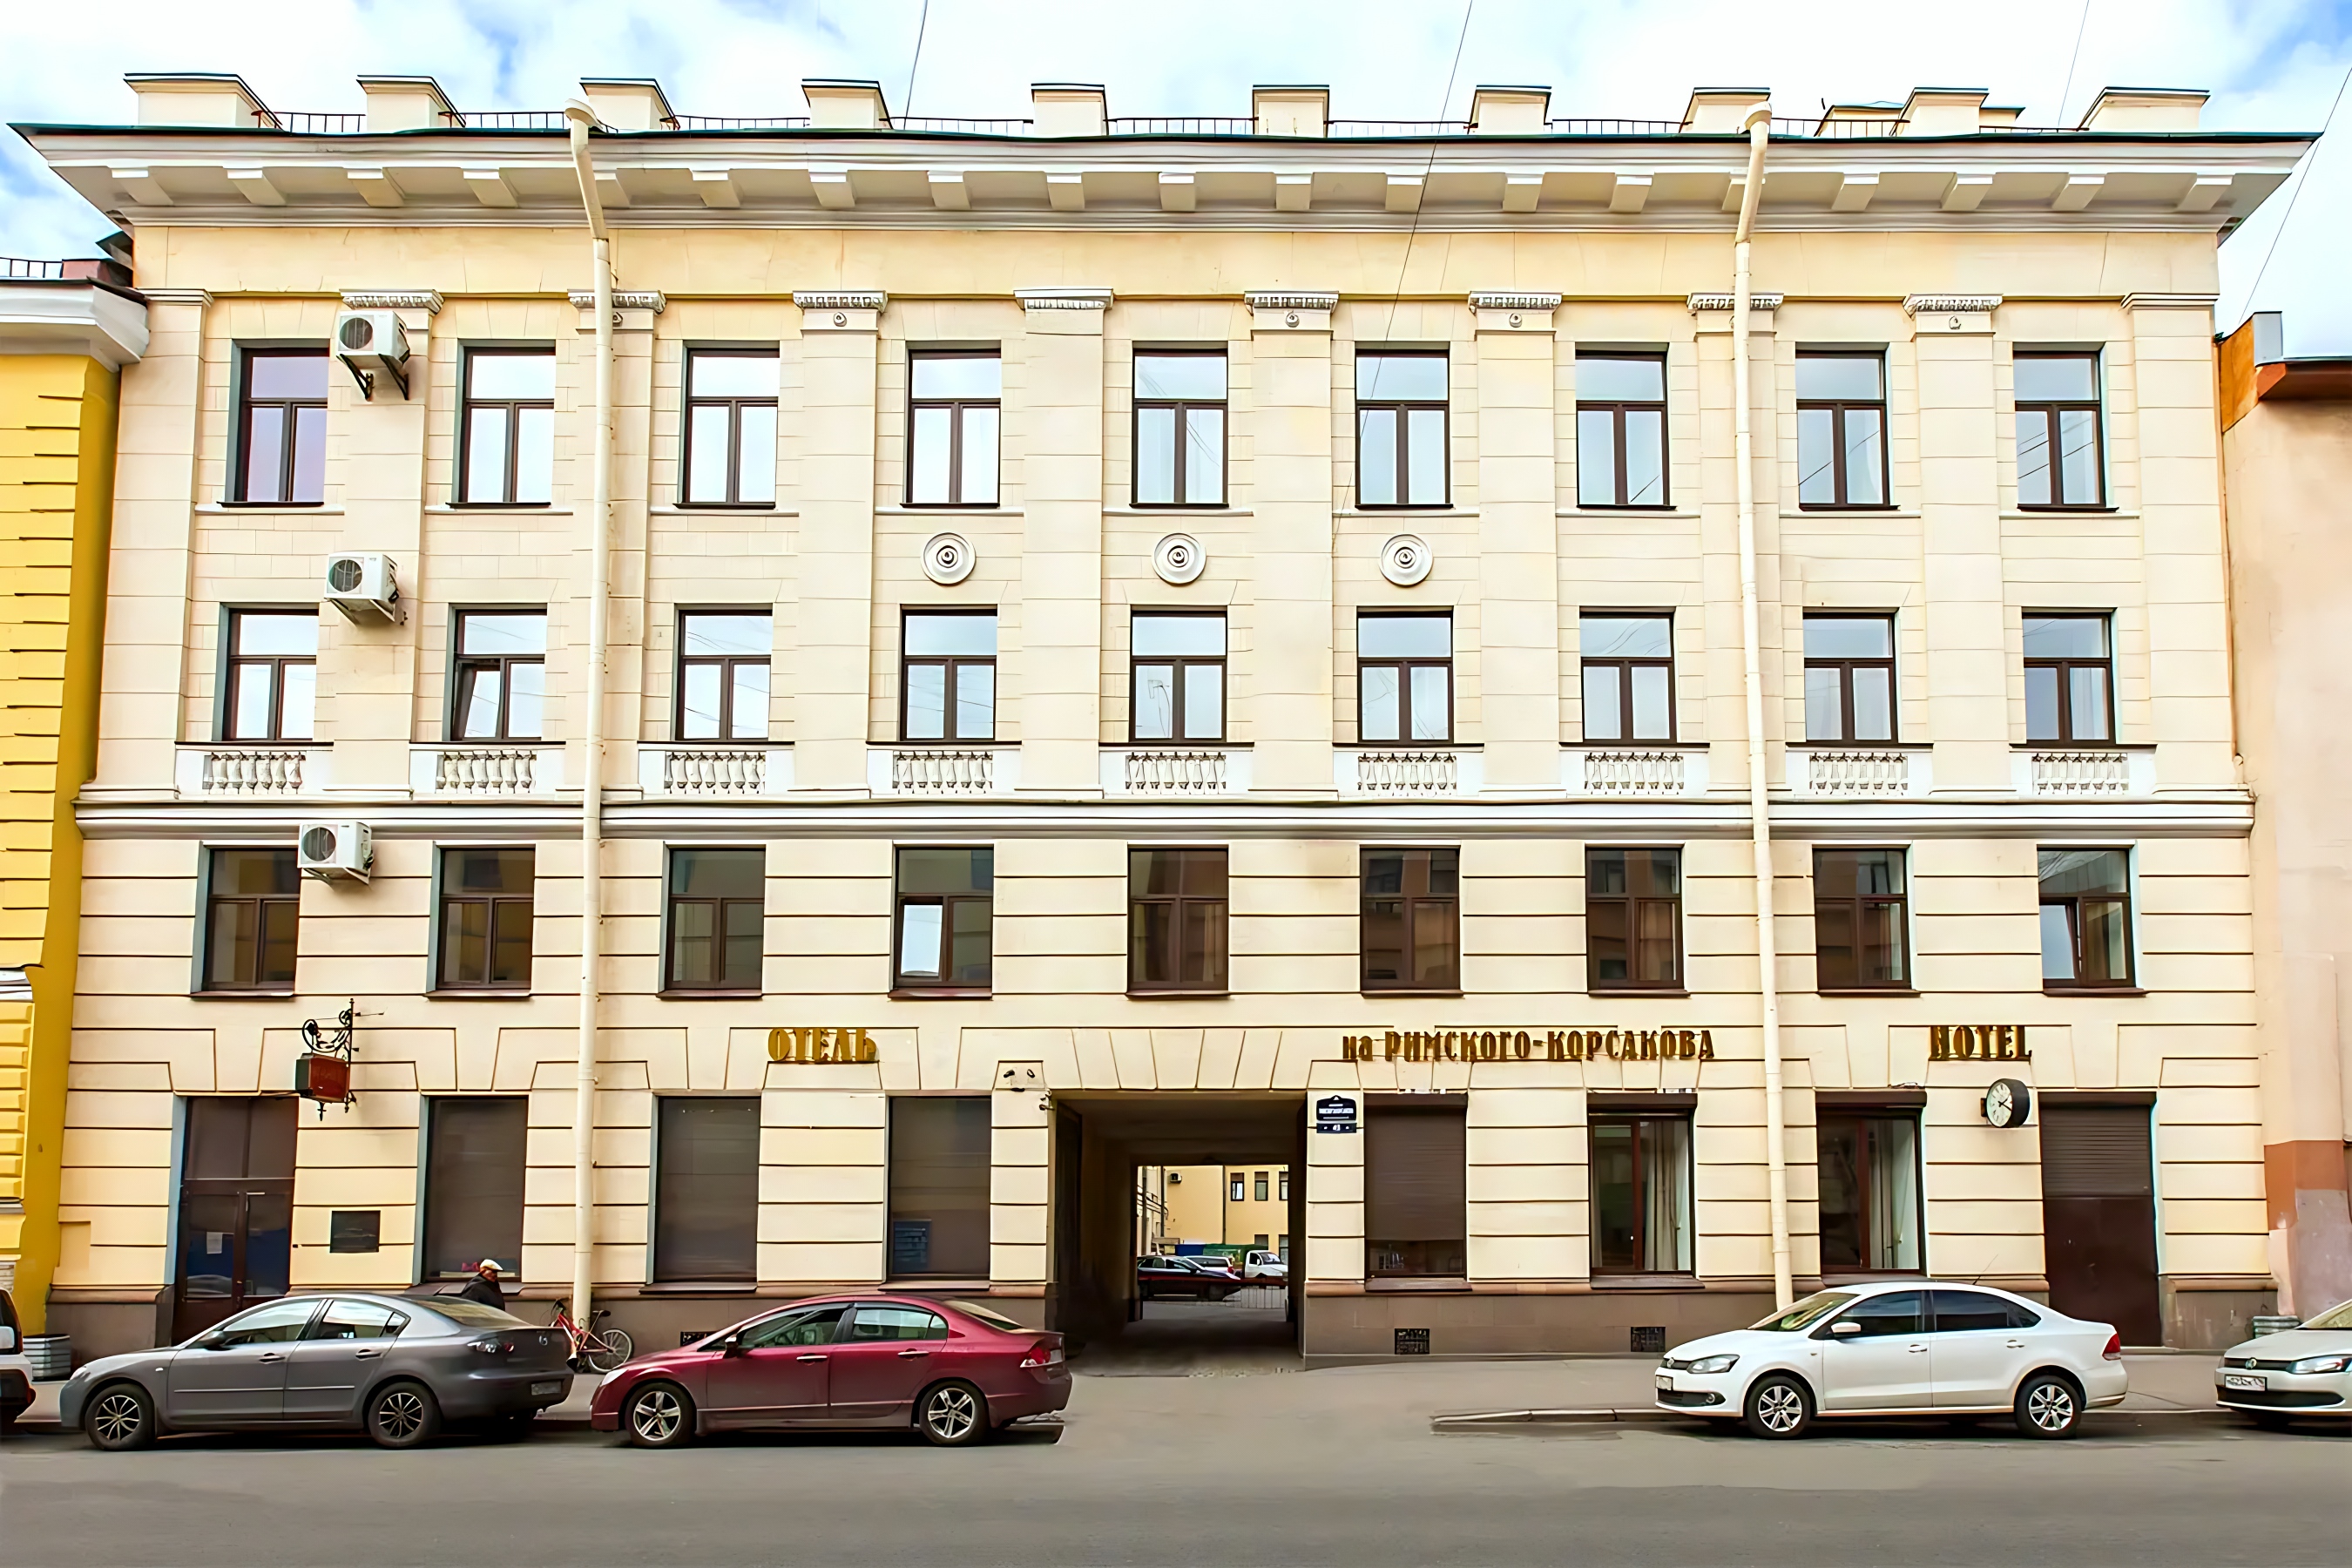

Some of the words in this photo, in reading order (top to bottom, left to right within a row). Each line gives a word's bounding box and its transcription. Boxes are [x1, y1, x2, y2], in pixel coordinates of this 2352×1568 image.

[767, 1027, 878, 1062] ОТЕЛЬ
[1342, 1035, 1374, 1062] на
[1930, 1025, 2032, 1061] HOTEL
